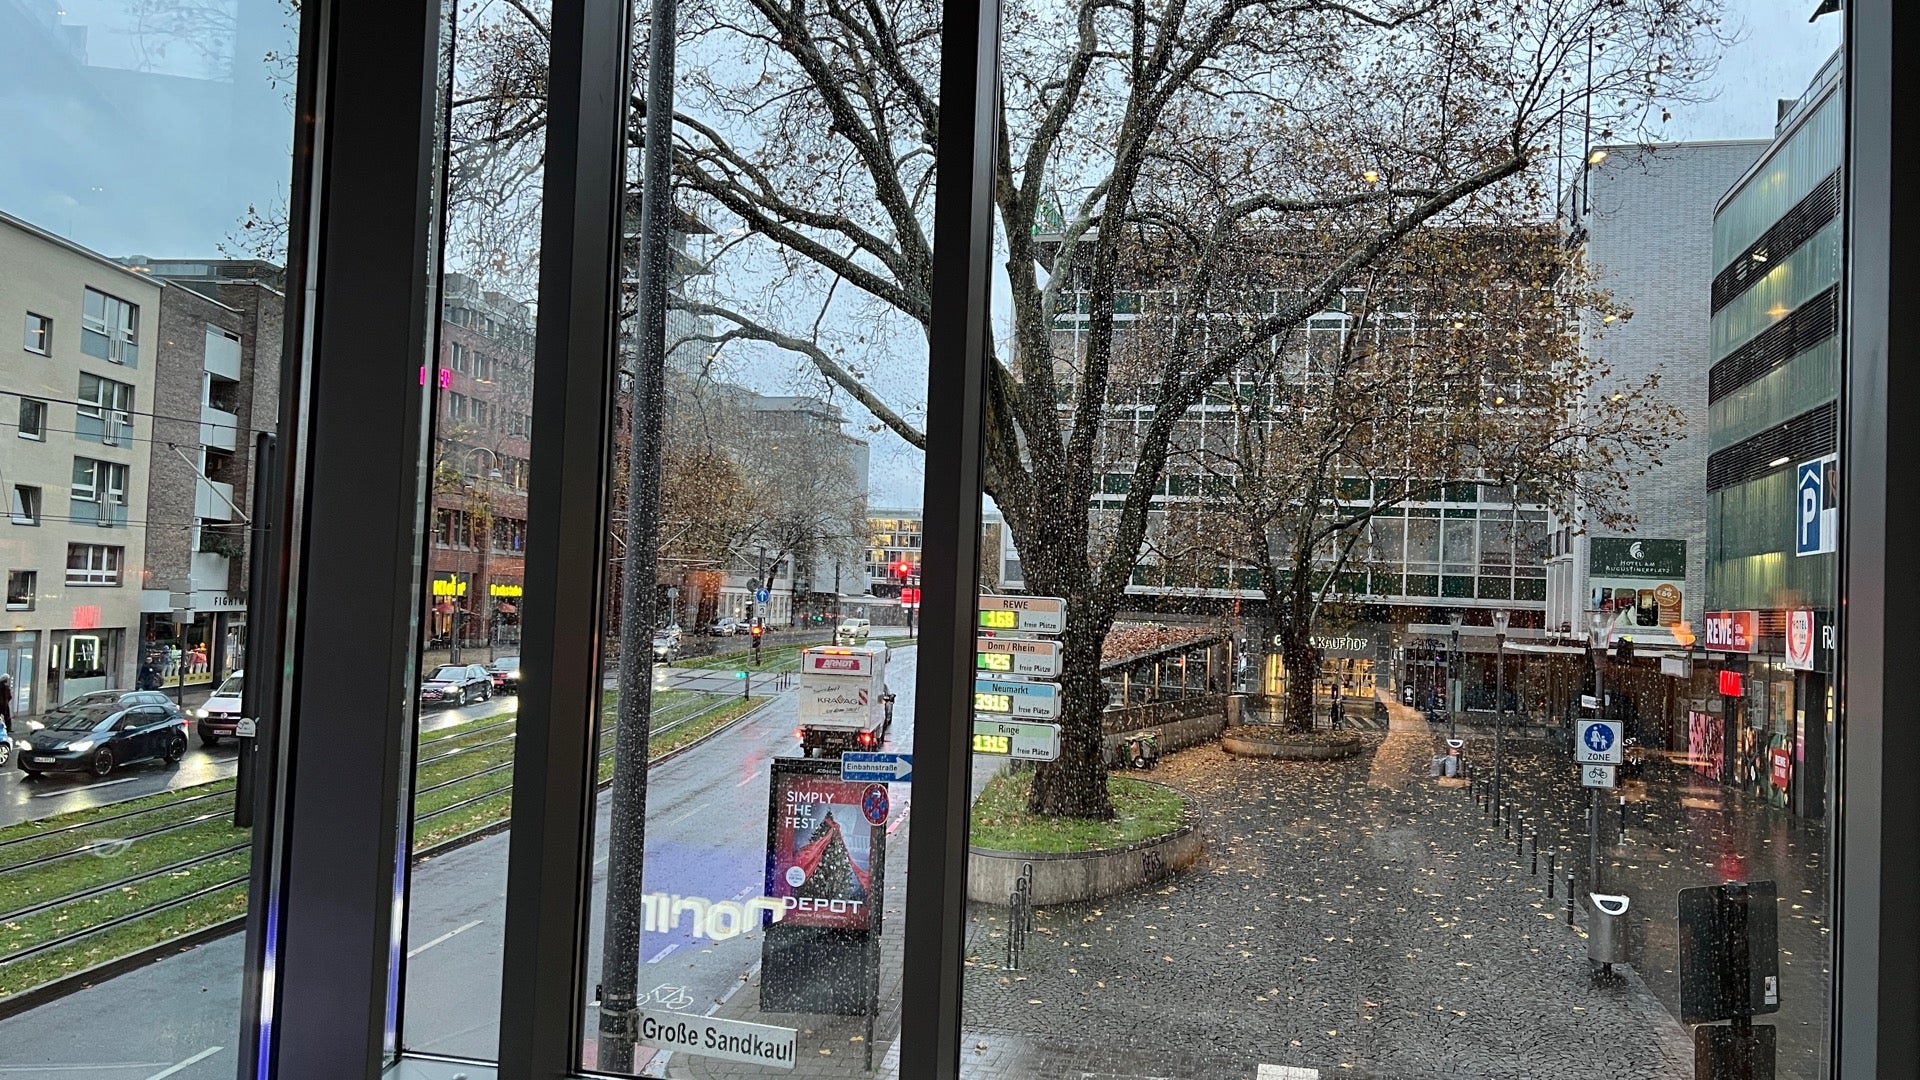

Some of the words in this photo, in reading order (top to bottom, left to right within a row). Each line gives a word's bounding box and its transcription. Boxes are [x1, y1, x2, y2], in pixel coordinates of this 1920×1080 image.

[1803, 487, 1816, 546] P
[1003, 600, 1028, 610] REWE
[1706, 618, 1732, 645] REWE
[987, 641, 1005, 651] Dom
[1012, 643, 1035, 653] Rhein
[1019, 664, 1031, 672] freie
[992, 683, 1029, 695] Neumarkt
[1018, 705, 1031, 713] freie
[998, 724, 1020, 735] Ringe
[1017, 747, 1030, 755] freie
[1587, 753, 1611, 761] ZONE
[846, 762, 898, 771] Einbahnstraße
[786, 790, 835, 804] SIMPLY
[786, 804, 812, 817] THE
[785, 817, 820, 830] FEST.
[782, 896, 863, 914] DEPOT
[642, 1016, 699, 1046] Große
[704, 1026, 794, 1062] Sandkaul
